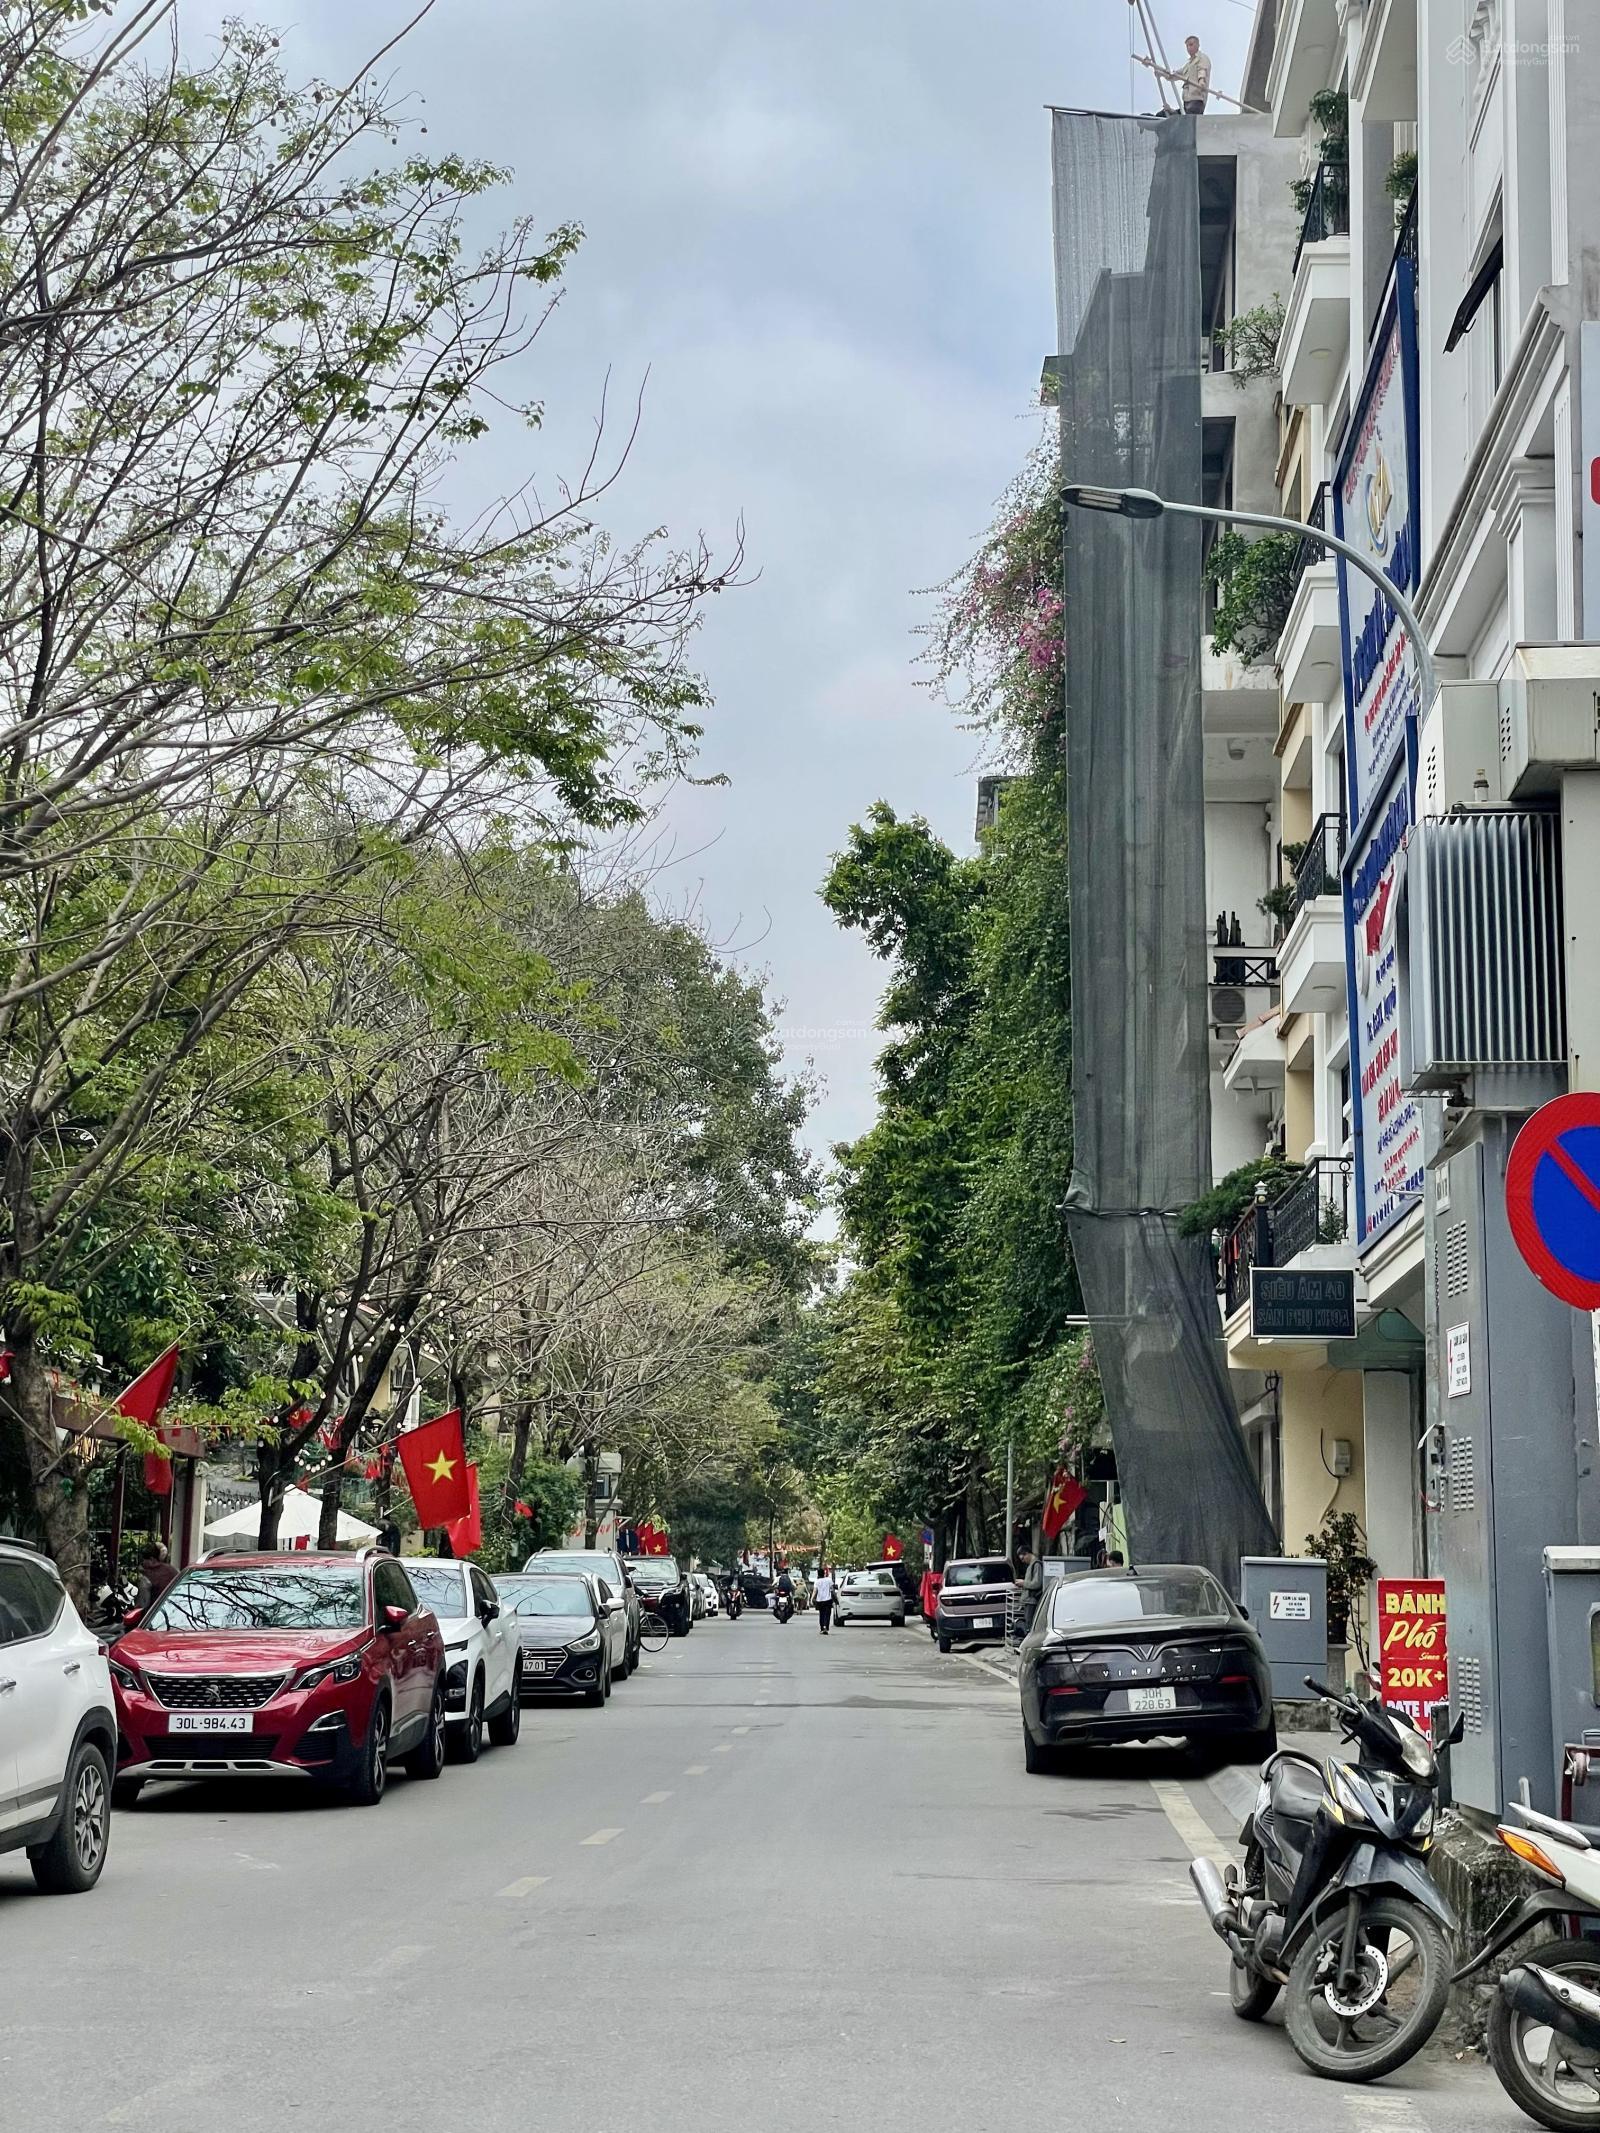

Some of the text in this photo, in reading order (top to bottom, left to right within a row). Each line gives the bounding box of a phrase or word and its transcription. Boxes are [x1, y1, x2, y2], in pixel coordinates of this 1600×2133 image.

[1298, 1276, 1322, 1300] ÂM
[1385, 1590, 1446, 1615] BÁNH
[1383, 1618, 1446, 1651] Phố
[1103, 1665, 1197, 1677] VINFAST
[1388, 1667, 1445, 1687] 20K+
[1143, 1689, 1162, 1699] 30H
[1135, 1699, 1171, 1711] 228.63
